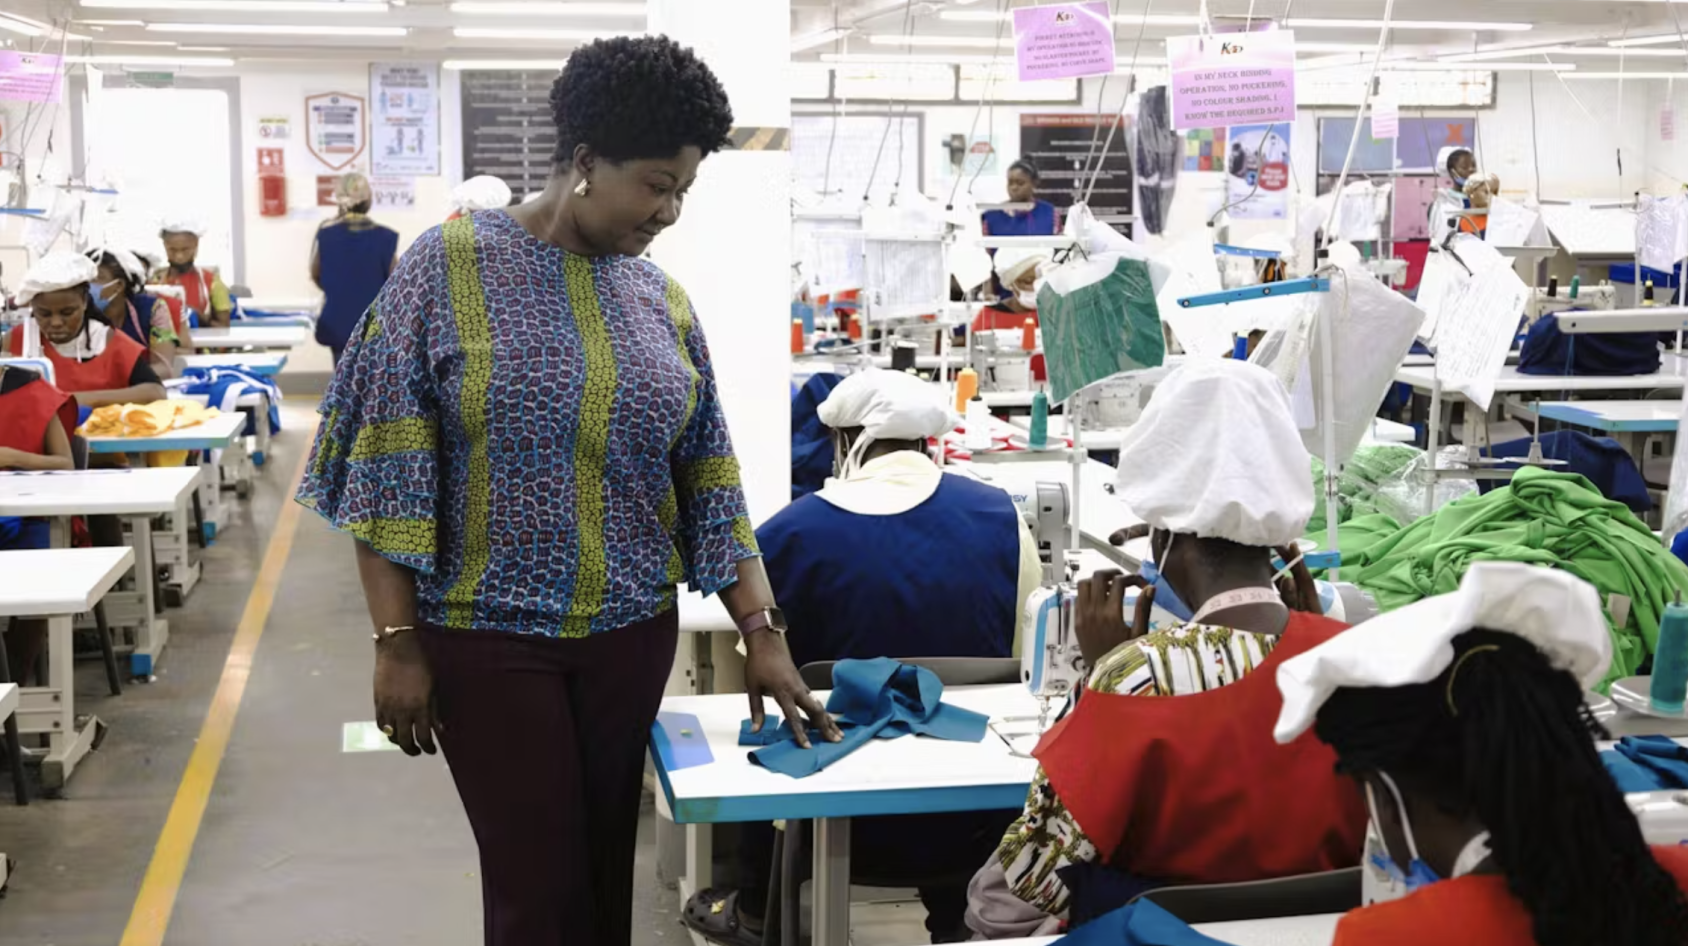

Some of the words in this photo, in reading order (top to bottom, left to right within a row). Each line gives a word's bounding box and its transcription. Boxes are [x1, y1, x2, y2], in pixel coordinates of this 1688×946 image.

[1194, 73, 1203, 81] IN
[1204, 71, 1217, 80] MY
[1217, 70, 1239, 79] NECK
[1240, 68, 1272, 77] BINDING
[1179, 83, 1227, 95] OPERATION,
[1228, 83, 1239, 92] NO
[1241, 80, 1288, 91] PUCKERING,
[1191, 98, 1202, 107] NO
[1203, 97, 1235, 106] COLOUR
[1184, 110, 1209, 120] KNOW
[1209, 109, 1225, 119] THE
[1226, 107, 1266, 117] REQUIRED
